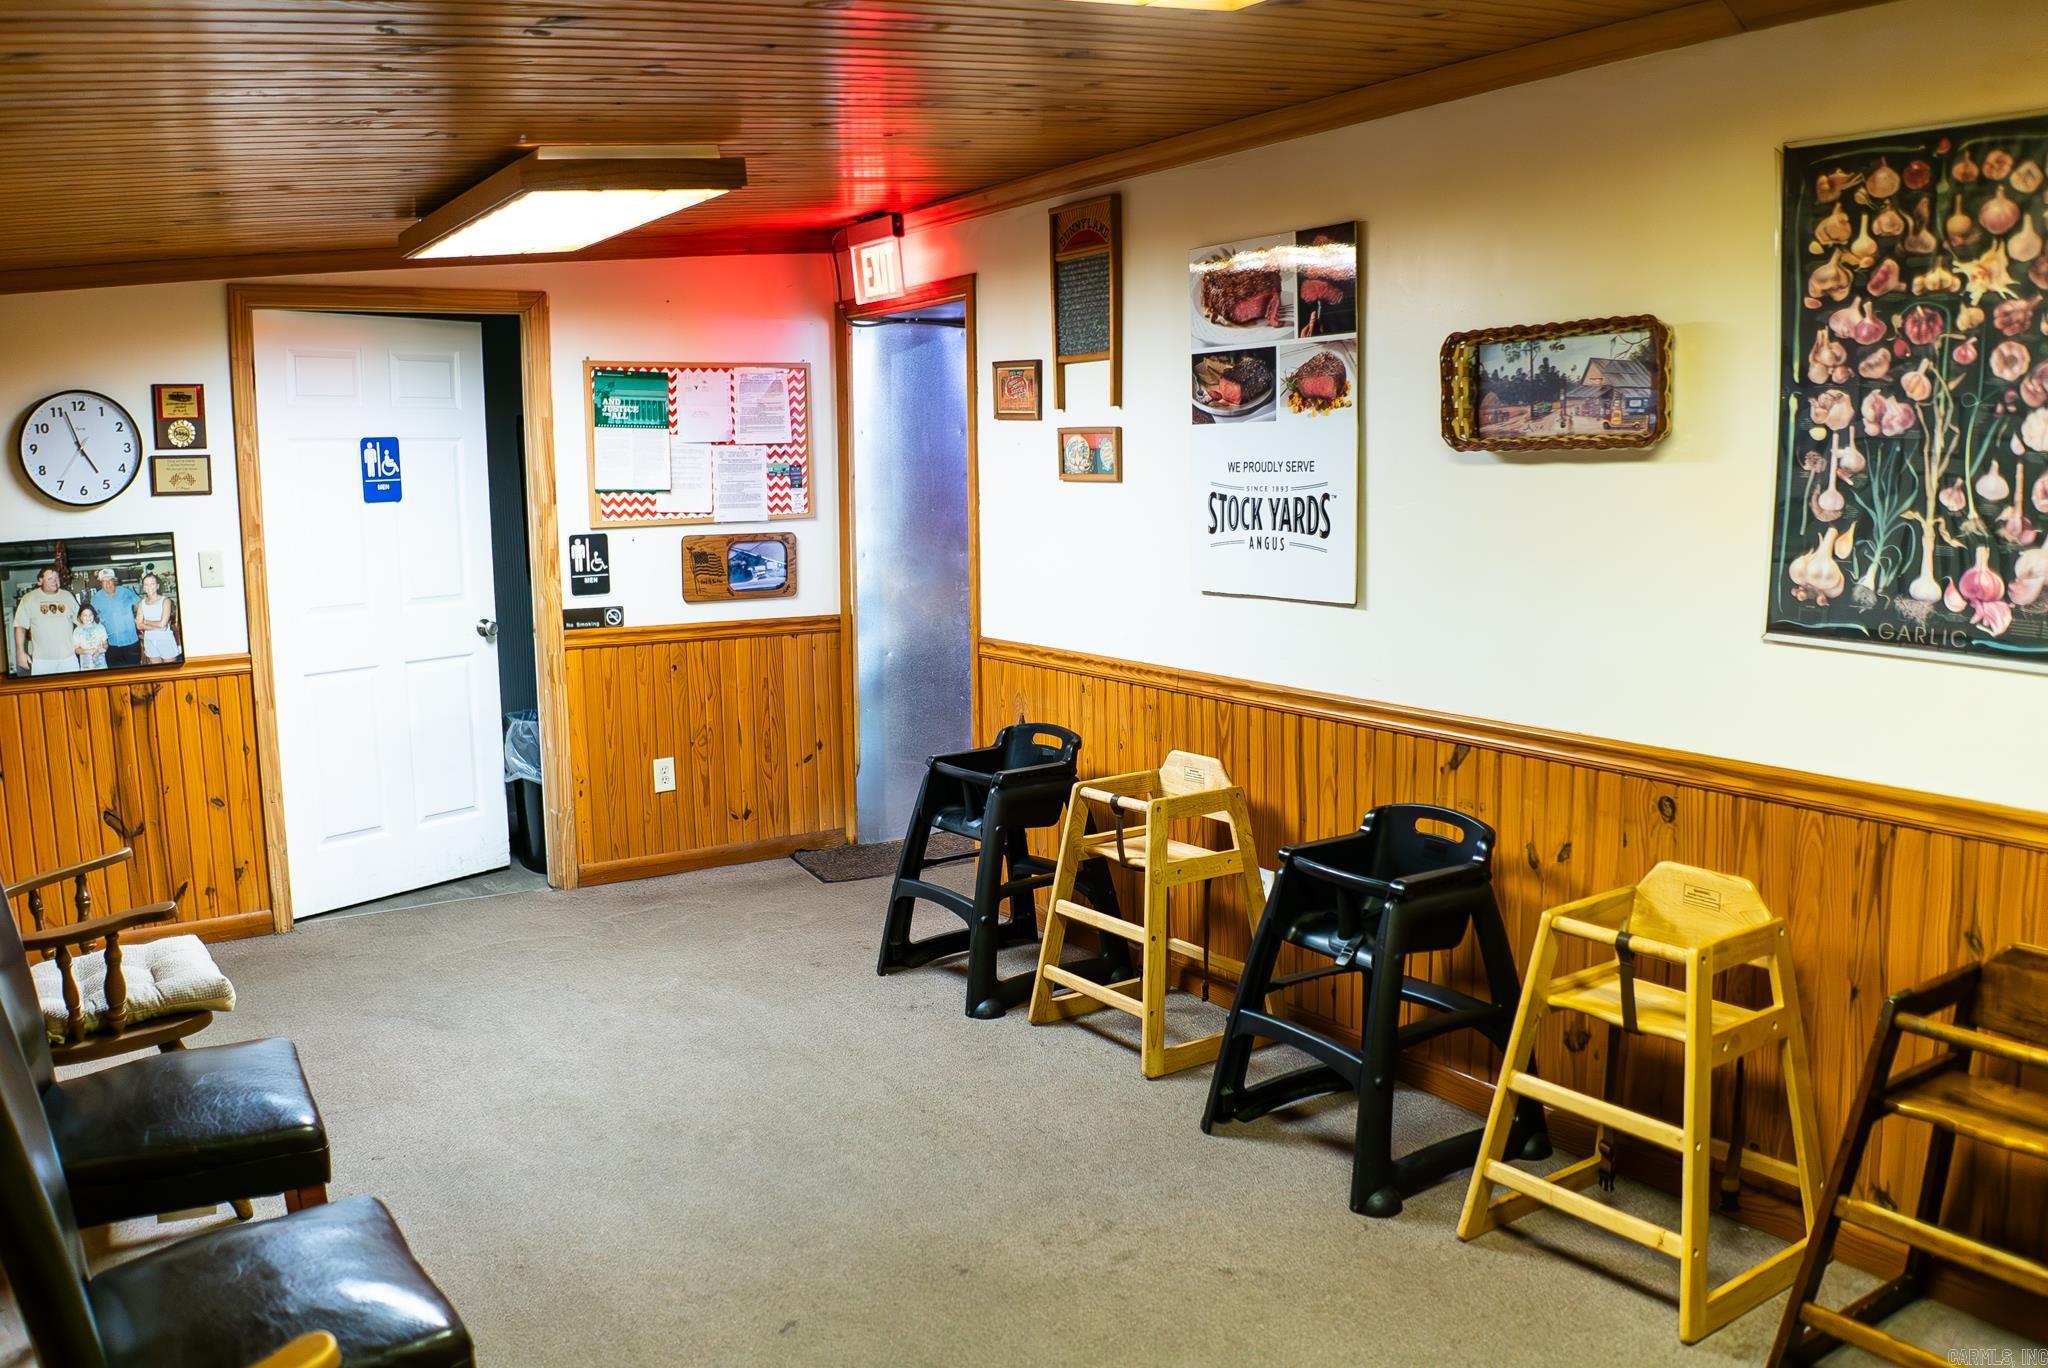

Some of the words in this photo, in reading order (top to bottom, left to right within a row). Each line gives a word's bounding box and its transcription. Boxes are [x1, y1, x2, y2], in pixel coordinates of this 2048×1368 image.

[861, 243, 897, 296] EXIT
[72, 400, 86, 412] 12
[602, 398, 621, 406] AND
[50, 407, 63, 418] 11
[98, 406, 104, 417] 1
[602, 405, 639, 413] JUSTICE
[612, 412, 628, 420] ALL
[34, 423, 49, 434] 10
[115, 421, 124, 433] 2
[29, 443, 38, 455] 9
[123, 442, 132, 453] 3
[38, 465, 47, 476] 8
[117, 463, 126, 473] 4
[1227, 461, 1241, 473] WE
[1243, 460, 1284, 473] PROUDLY
[1285, 460, 1315, 473] SERVE
[56, 480, 65, 491] 7
[102, 479, 111, 490] 5
[1246, 485, 1268, 493] SINCE
[1272, 485, 1289, 493] 1893
[80, 485, 88, 496] 6
[1208, 491, 1263, 535] STOCK
[1268, 492, 1331, 539] YARDS
[1249, 536, 1285, 551] ANGUS
[1878, 622, 1967, 648] GARLIC
